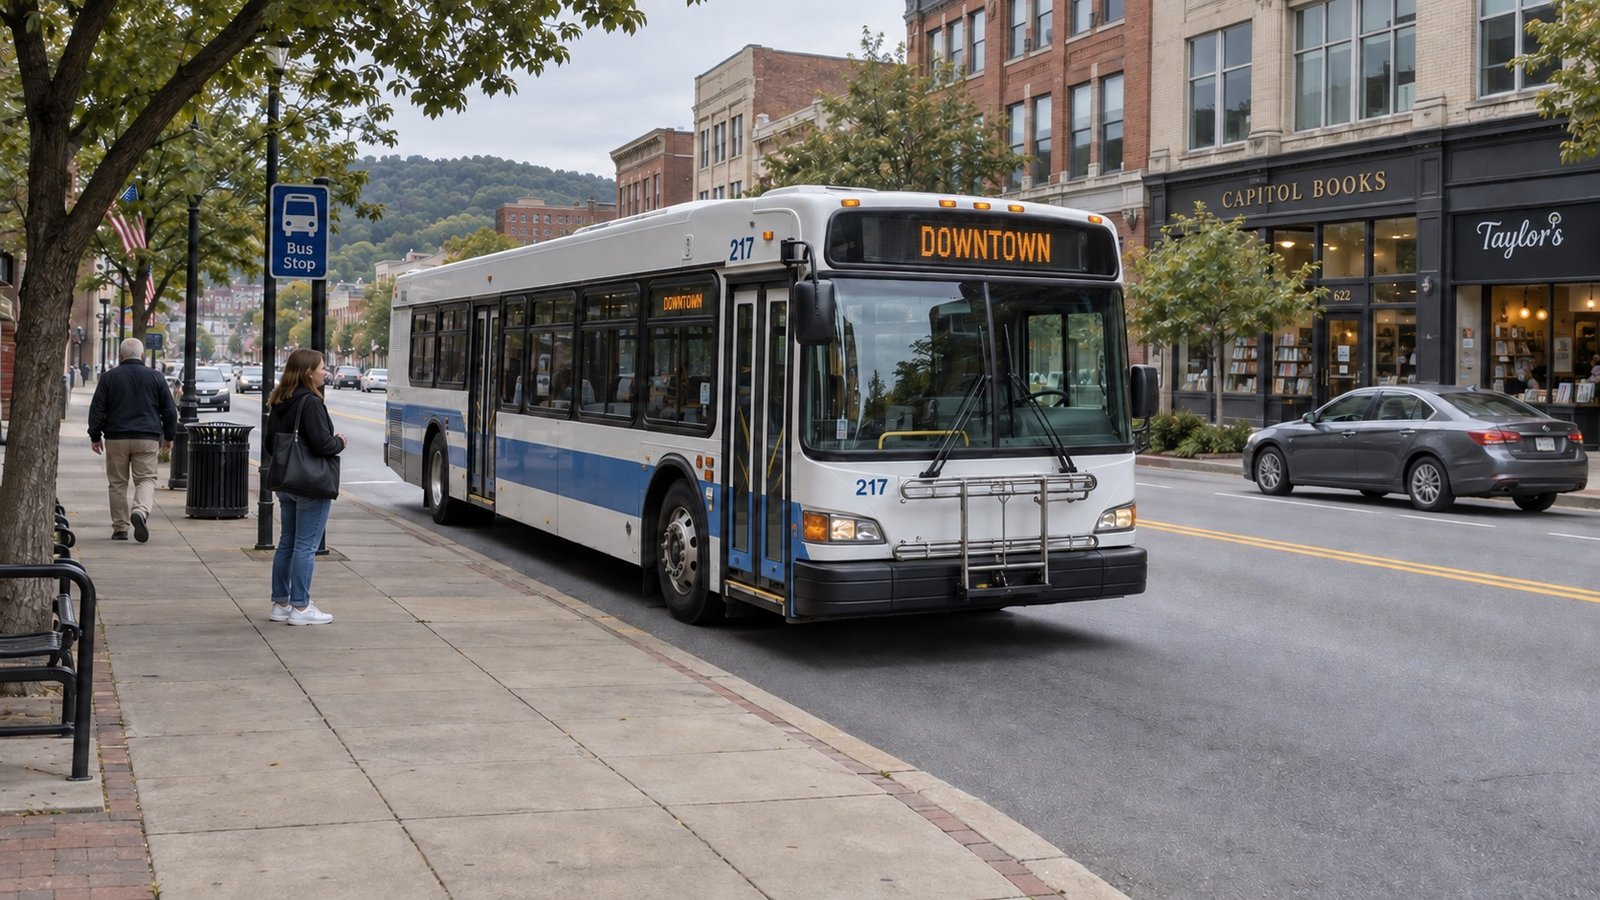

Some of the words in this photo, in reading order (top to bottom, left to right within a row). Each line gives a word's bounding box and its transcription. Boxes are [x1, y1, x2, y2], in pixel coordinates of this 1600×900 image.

[1222, 182, 1303, 208] CAPITOL
[1312, 170, 1387, 198] BOOKS
[921, 225, 1051, 263] DOWNTOWN
[1476, 211, 1564, 259] Taylor's
[287, 241, 313, 255] Bus
[729, 236, 755, 261] 217
[283, 256, 316, 272] Stop
[1334, 289, 1351, 301] 622
[855, 478, 888, 496] 217
